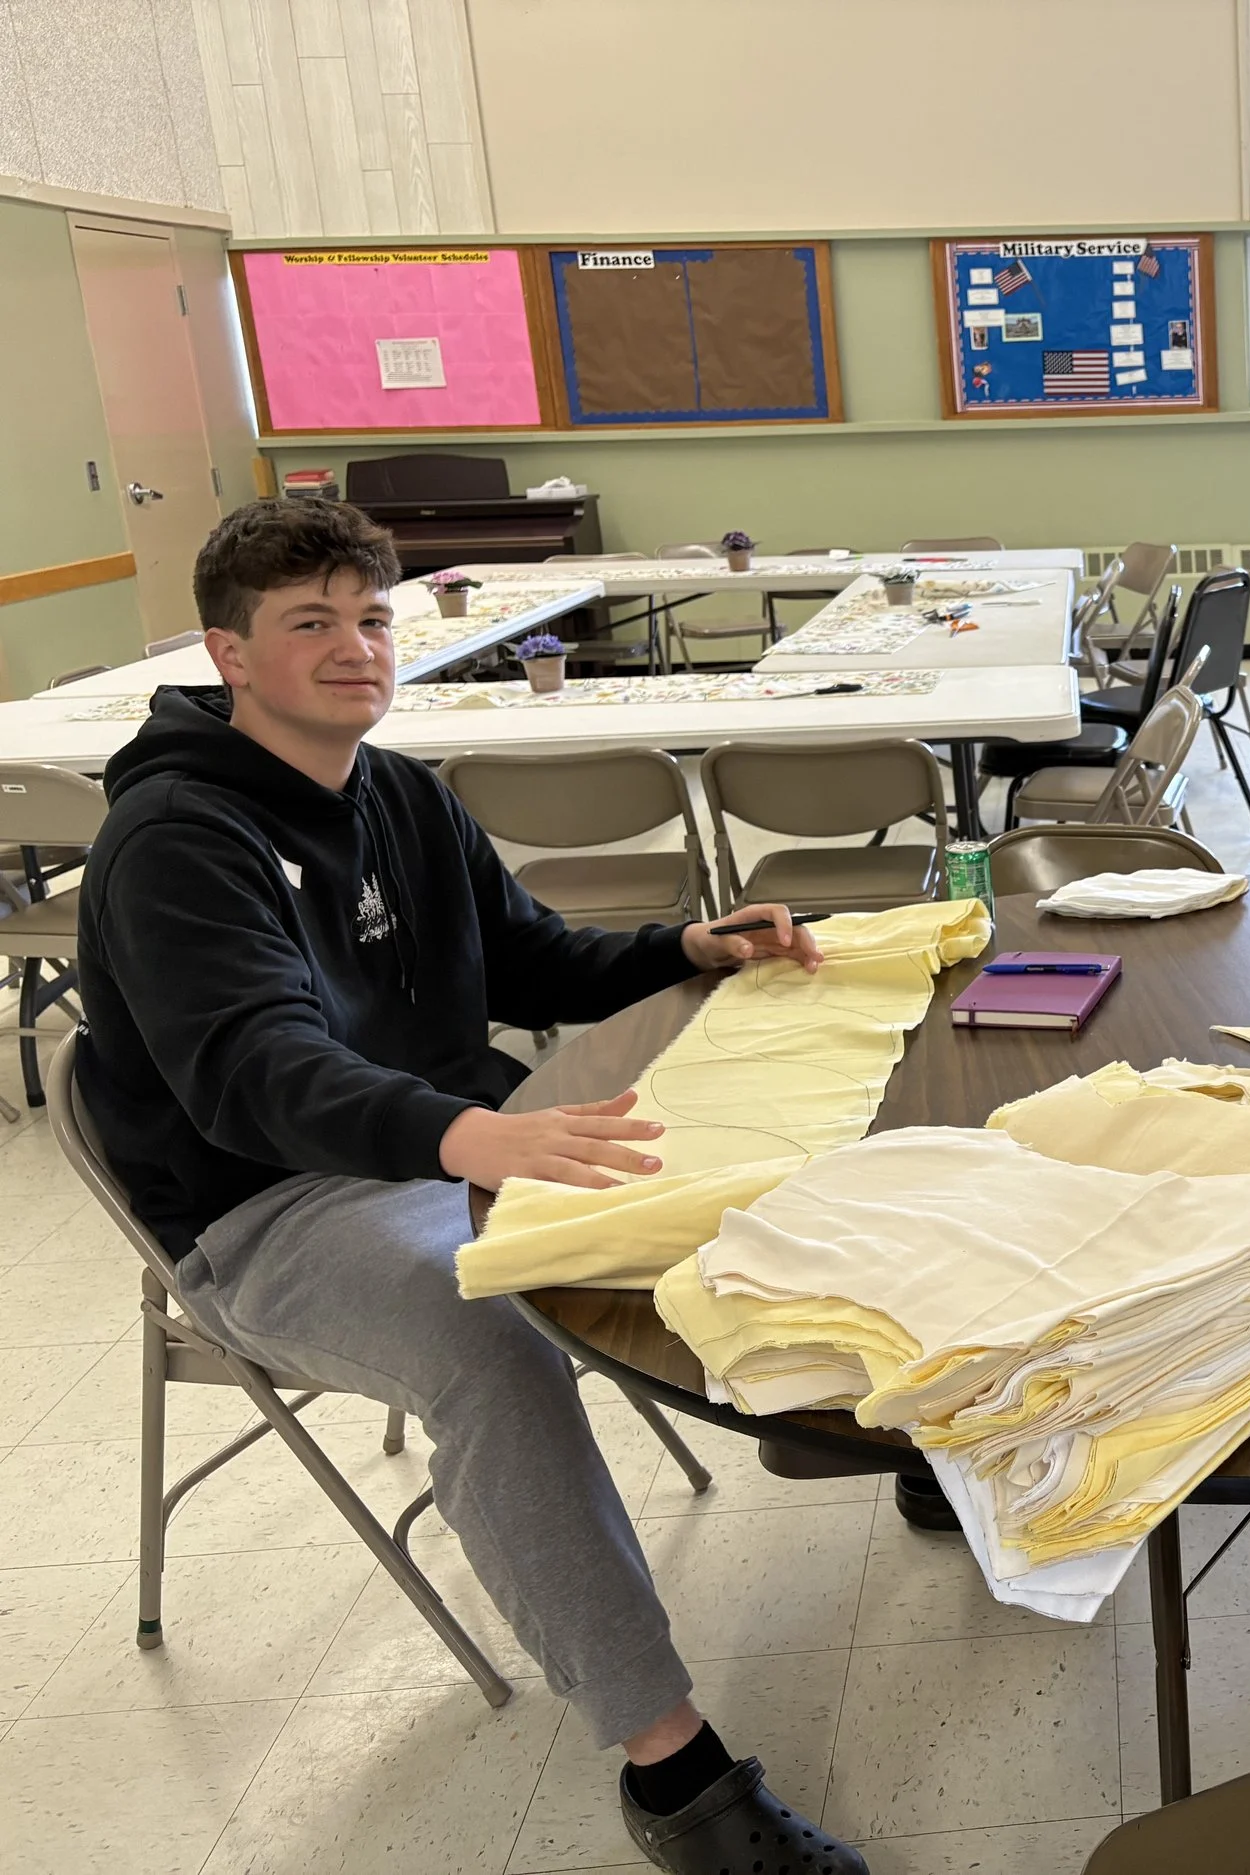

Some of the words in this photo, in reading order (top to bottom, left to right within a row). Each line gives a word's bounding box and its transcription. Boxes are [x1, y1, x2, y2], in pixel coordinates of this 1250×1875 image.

[1003, 243, 1075, 256] Military
[1077, 241, 1141, 255] Service
[284, 255, 324, 264] Worship
[337, 254, 390, 264] Fellowship
[391, 253, 438, 261] Volunteer
[441, 253, 489, 261] Schedules
[580, 252, 652, 266] Finance
